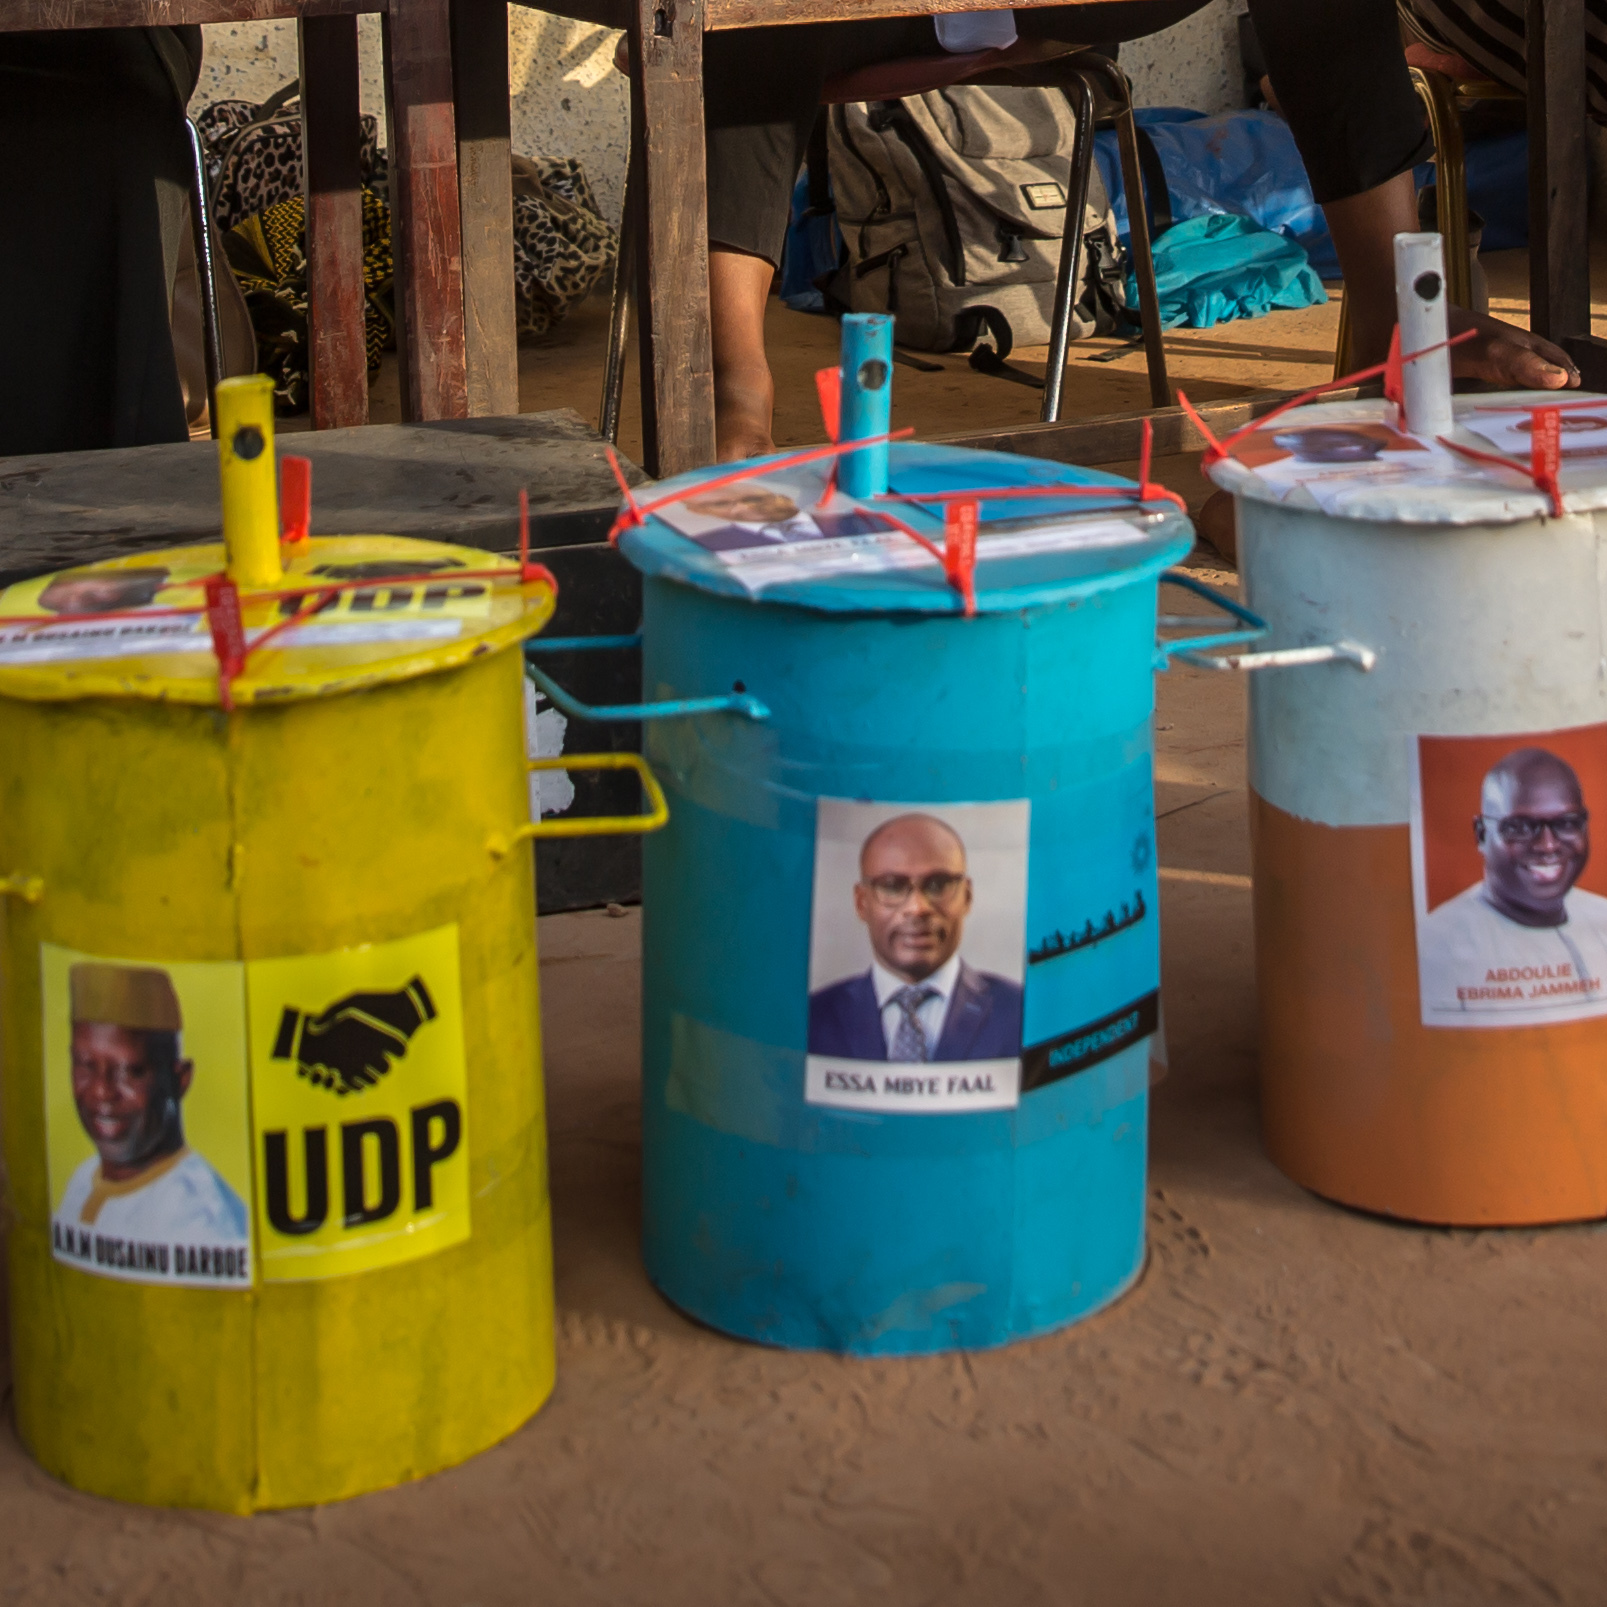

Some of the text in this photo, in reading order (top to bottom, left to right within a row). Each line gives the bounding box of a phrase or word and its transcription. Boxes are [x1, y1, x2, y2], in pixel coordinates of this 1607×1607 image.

[1484, 961, 1573, 984] ABDOULIE
[1455, 977, 1601, 1001] EBRIMA JAMMEH
[824, 1071, 997, 1095] ESSA MBYE FAAL
[263, 1097, 462, 1237] UDP
